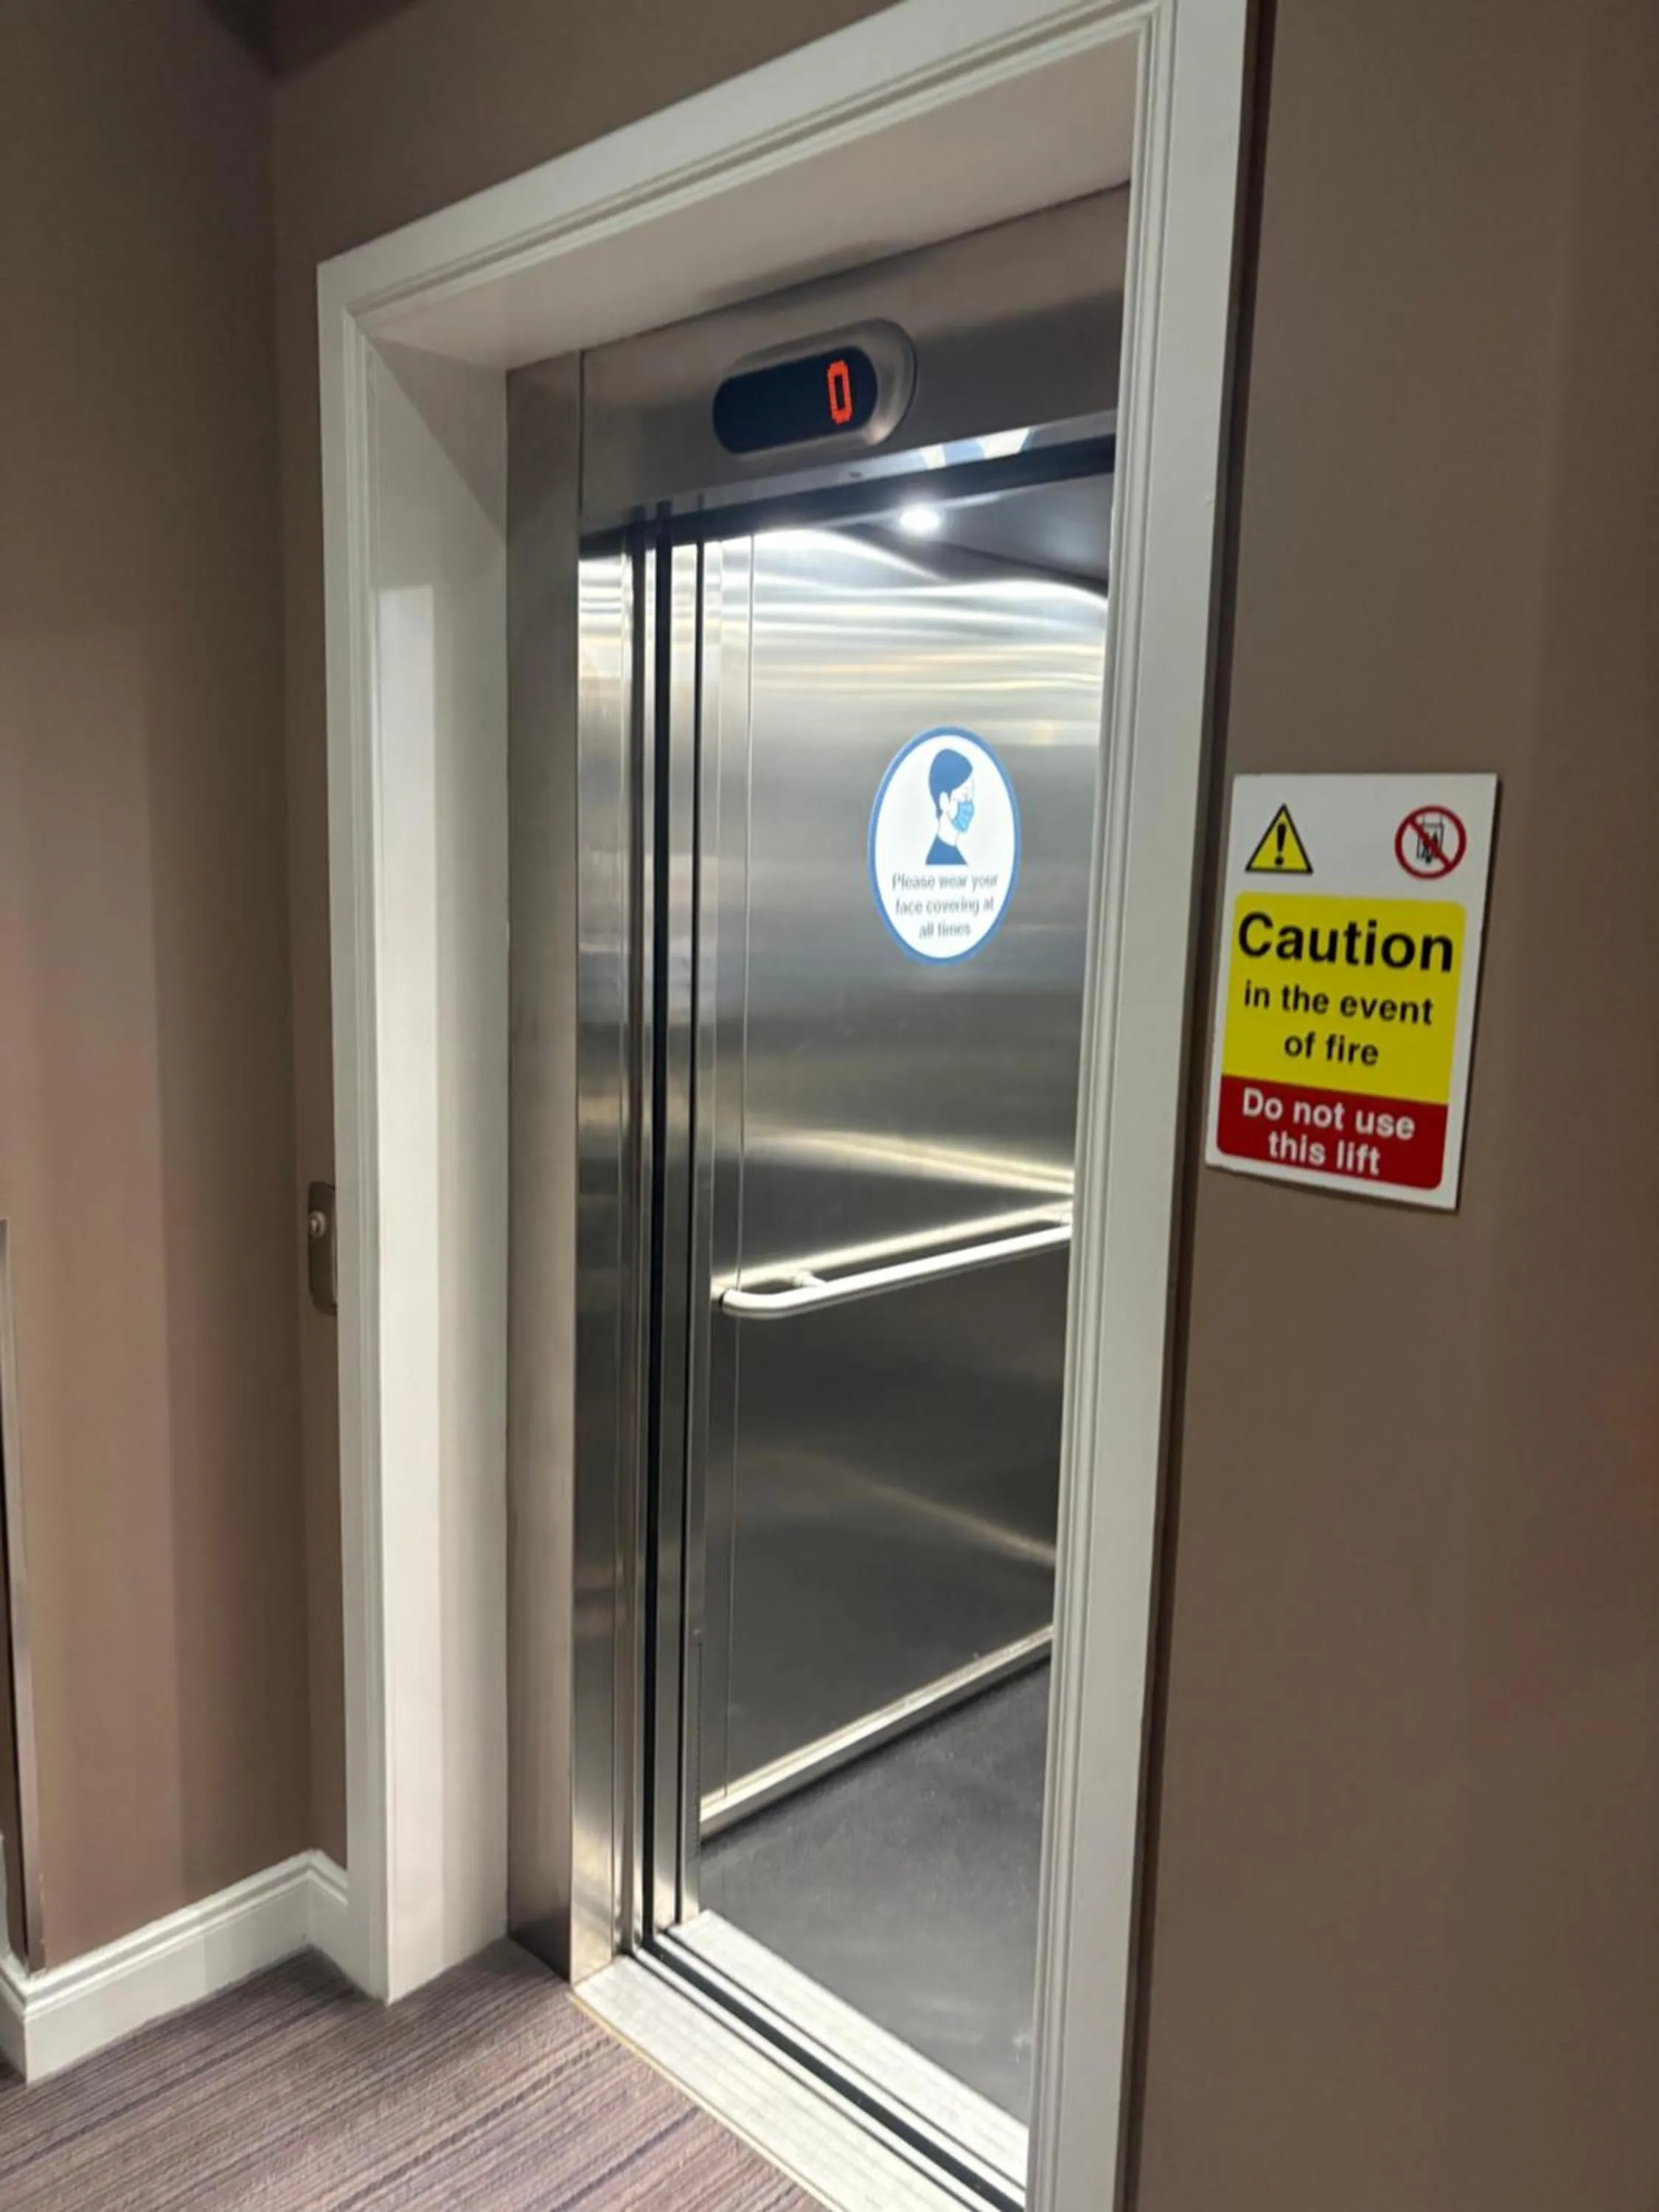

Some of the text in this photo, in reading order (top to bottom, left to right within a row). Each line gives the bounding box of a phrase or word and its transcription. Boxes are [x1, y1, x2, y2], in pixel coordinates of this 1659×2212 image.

[827, 359, 852, 424] 0
[892, 874, 998, 891] Please wear your
[896, 894, 994, 917] face covering at
[920, 921, 970, 938] all times
[1238, 911, 1453, 973] Caution
[1244, 980, 1433, 1026] in the event
[1284, 1032, 1379, 1066] of fire
[1242, 1088, 1416, 1140] Do not use
[1268, 1132, 1380, 1175] this lift
